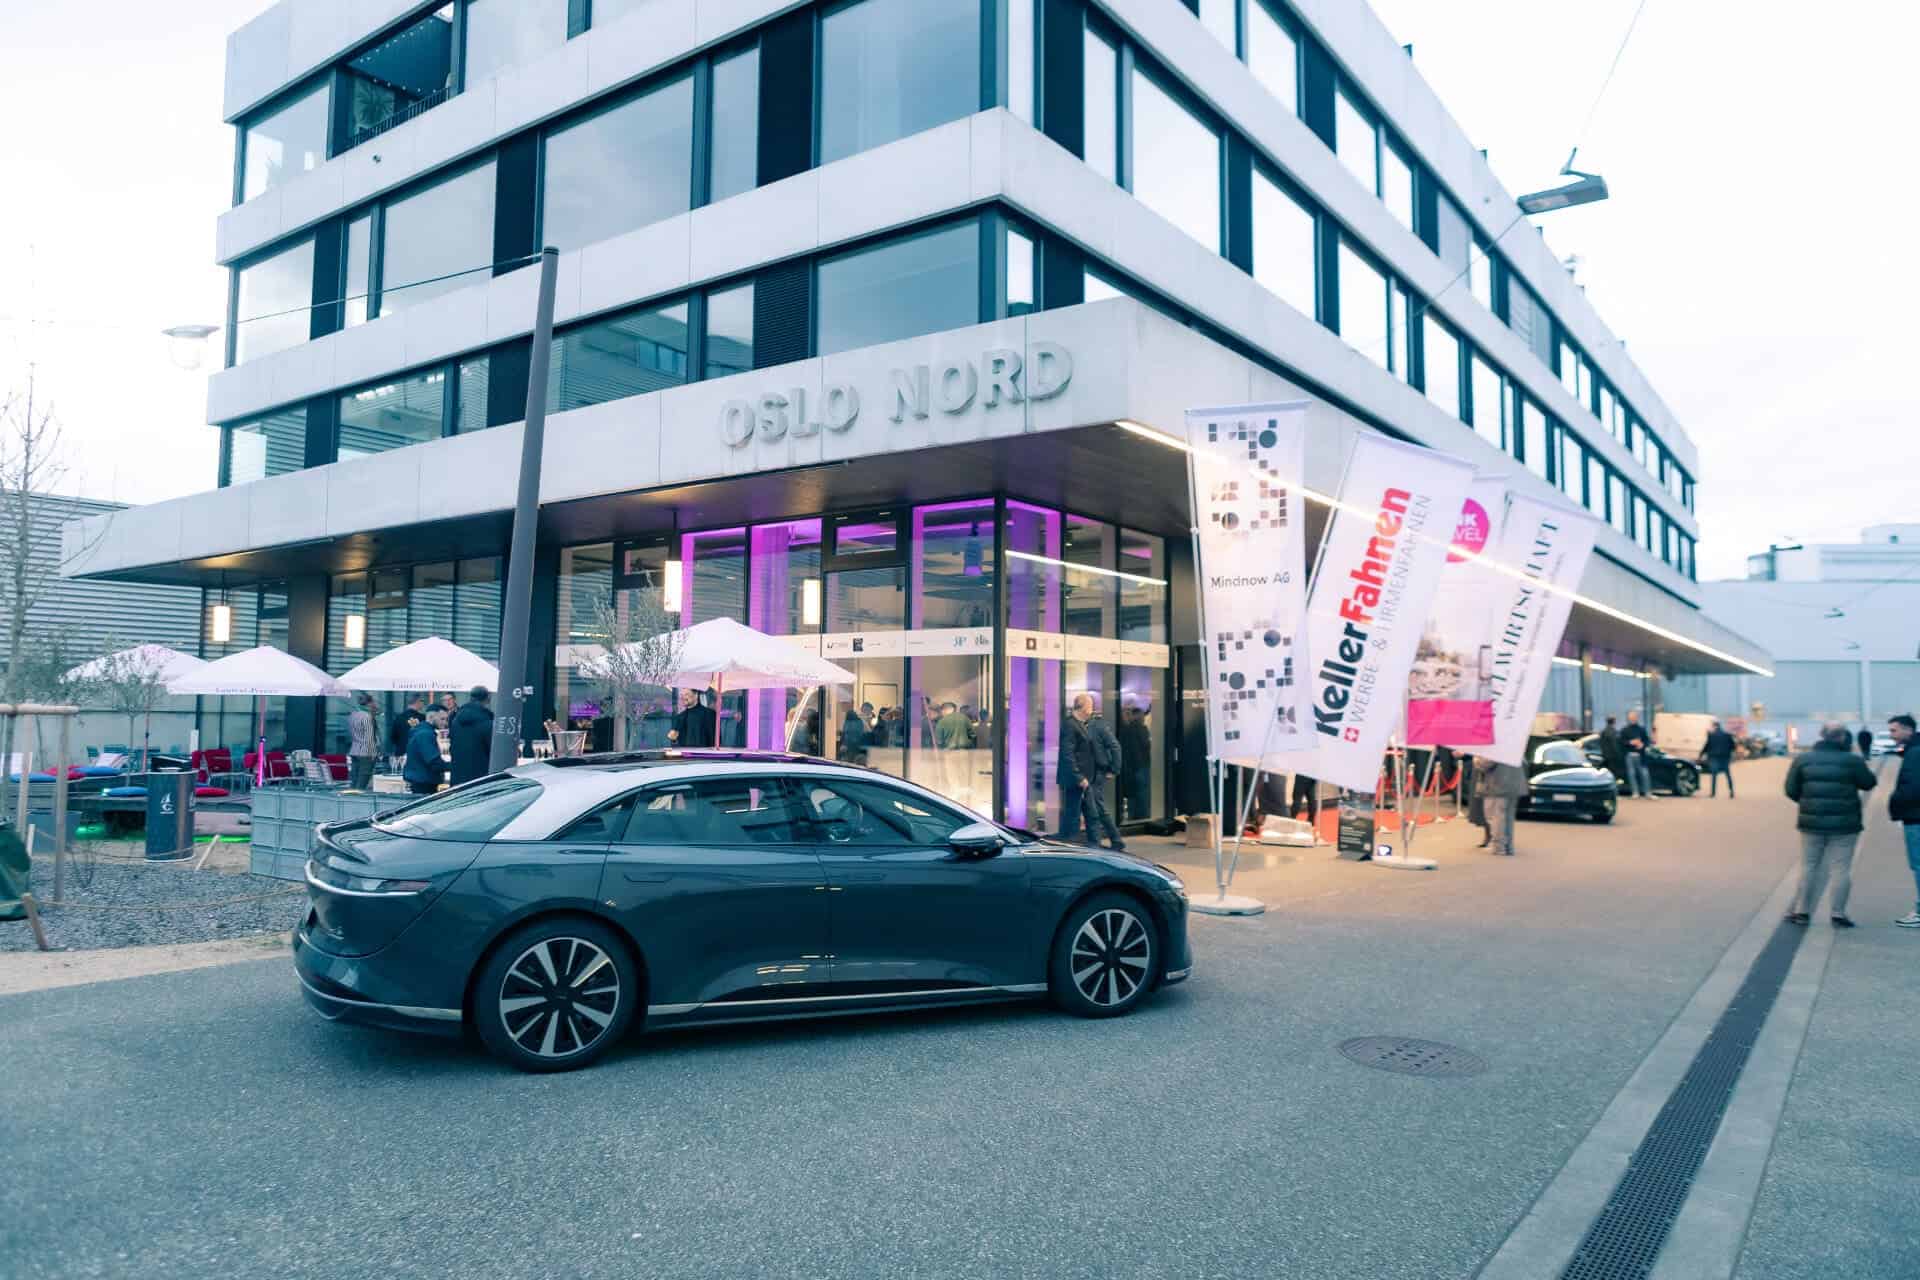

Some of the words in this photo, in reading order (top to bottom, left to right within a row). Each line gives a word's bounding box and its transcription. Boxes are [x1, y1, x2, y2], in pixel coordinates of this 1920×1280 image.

[720, 383, 860, 449] OSLO
[889, 341, 1074, 425] NORD
[1453, 526, 1485, 542] VEL
[1211, 575, 1268, 589] Mindnow
[1272, 571, 1291, 584] AG
[1312, 487, 1413, 737] KellerFahnen
